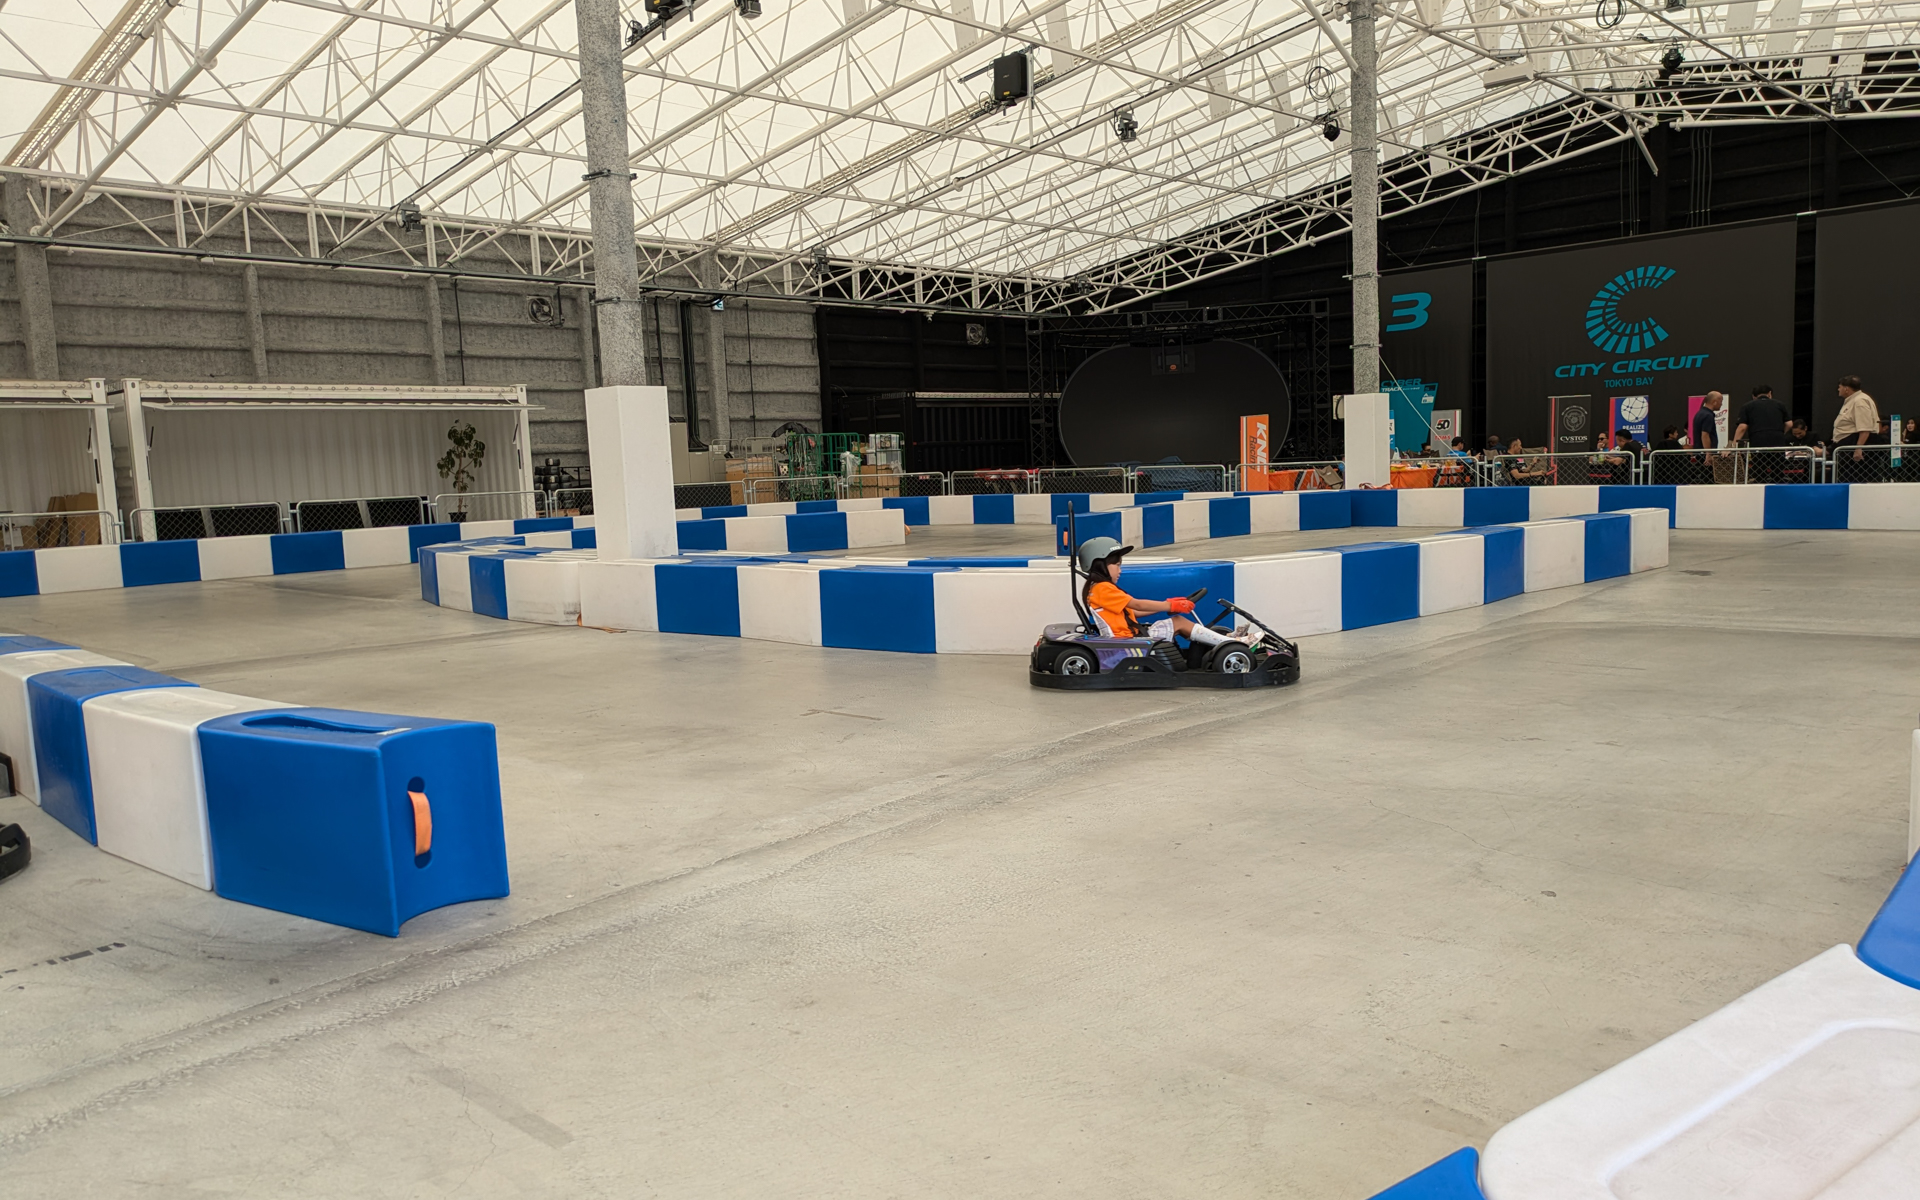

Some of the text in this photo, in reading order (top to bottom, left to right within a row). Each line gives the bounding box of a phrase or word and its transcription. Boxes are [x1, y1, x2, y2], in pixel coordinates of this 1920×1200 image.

[1386, 292, 1432, 332] 3
[1554, 354, 1709, 378] CITY CIRCUIT
[1381, 378, 1422, 387] CYBER
[1604, 377, 1654, 388] TOKYO BAY
[1435, 419, 1451, 430] 50
[1249, 435, 1257, 471] Racing
